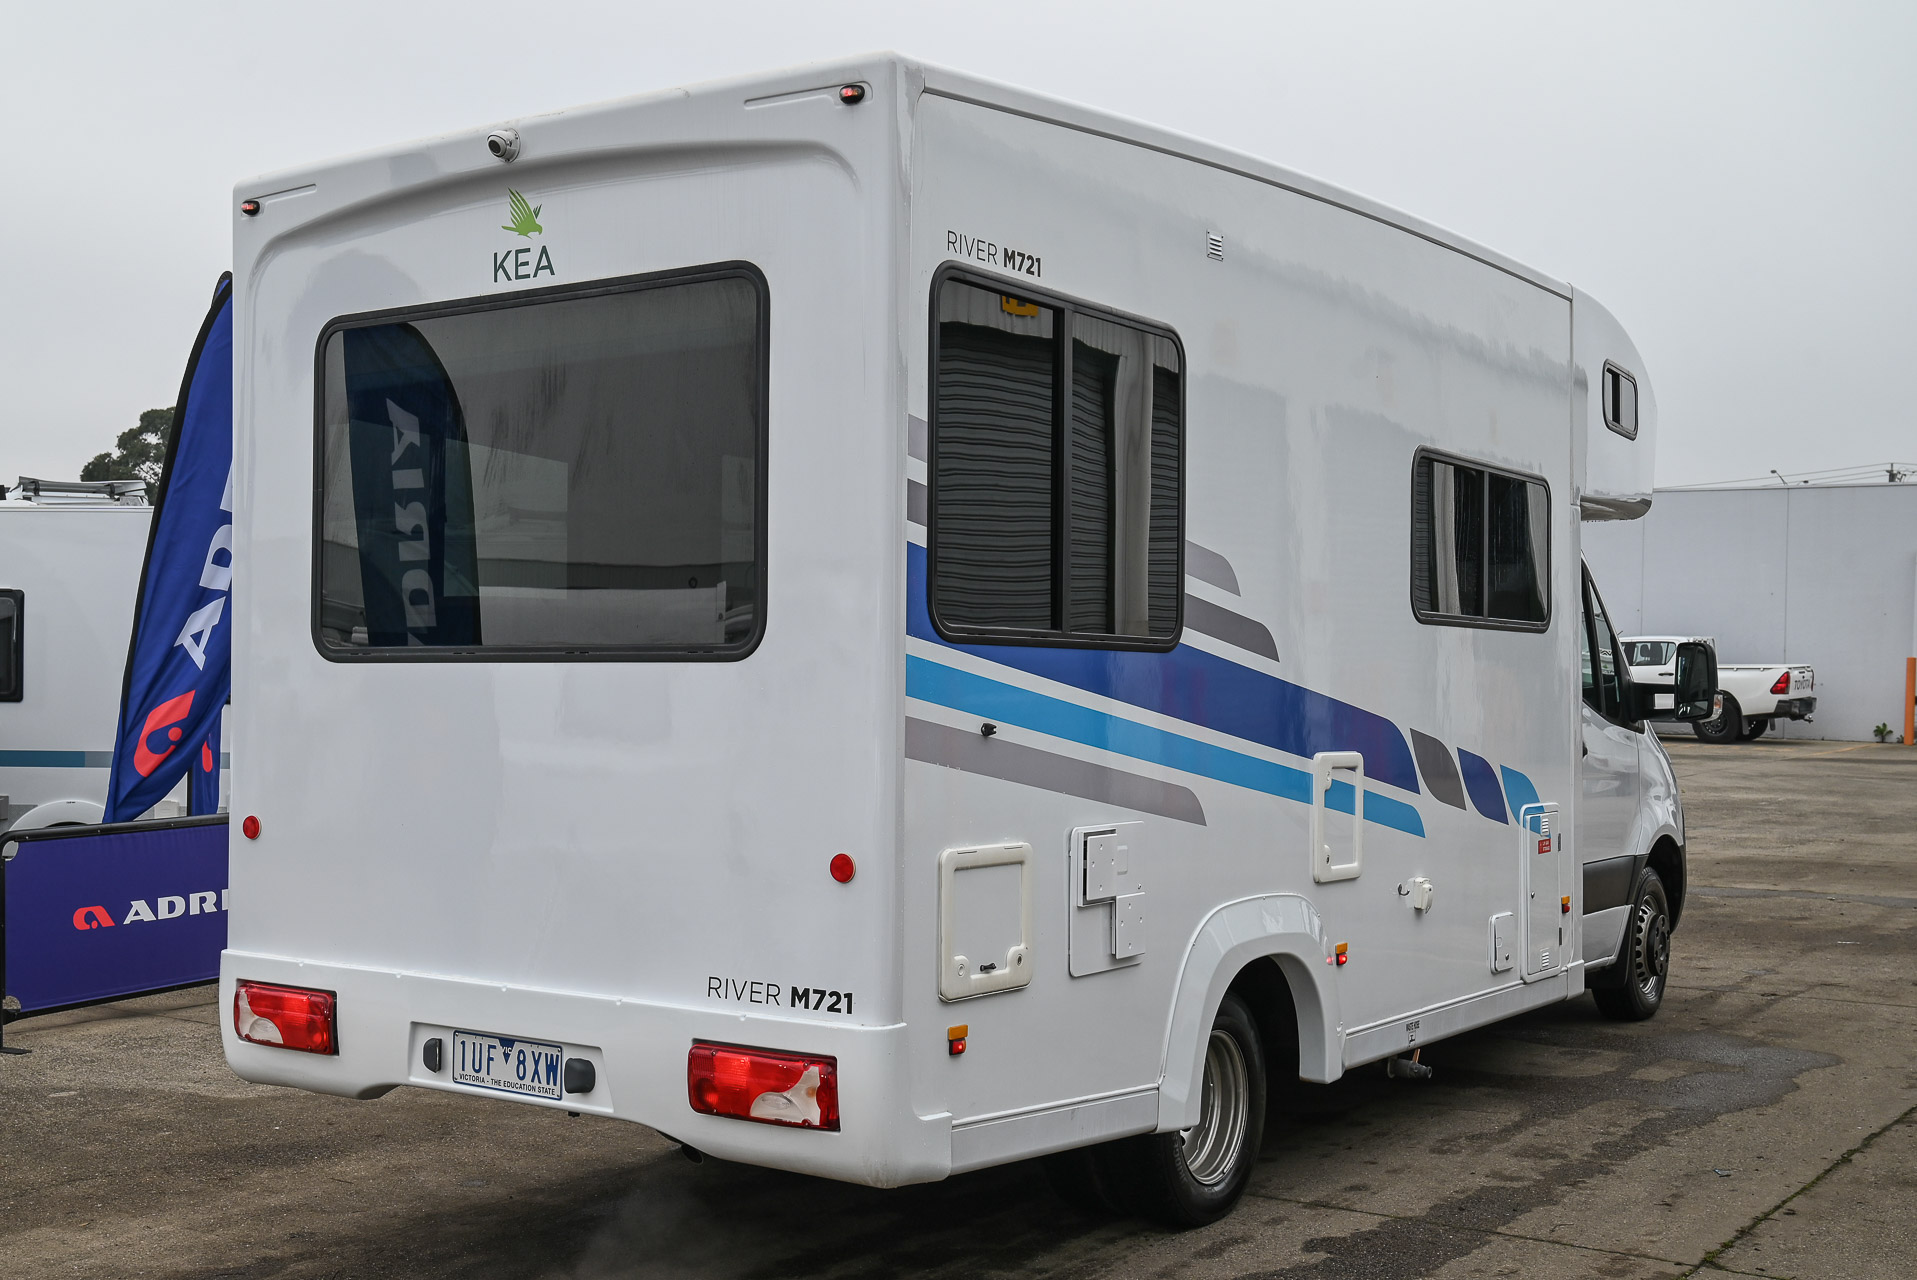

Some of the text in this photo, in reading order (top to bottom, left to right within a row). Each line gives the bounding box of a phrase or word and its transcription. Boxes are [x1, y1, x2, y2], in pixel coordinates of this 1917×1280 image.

[493, 245, 556, 283] KEA
[947, 230, 1041, 278] RIVER M721
[707, 976, 853, 1015] RIVER M721
[460, 1040, 560, 1087] 1UF 8XW
[459, 1072, 486, 1084] VICTORIA
[490, 1078, 502, 1087] THE
[503, 1080, 536, 1092] EDUCATION
[537, 1086, 556, 1096] STATE
